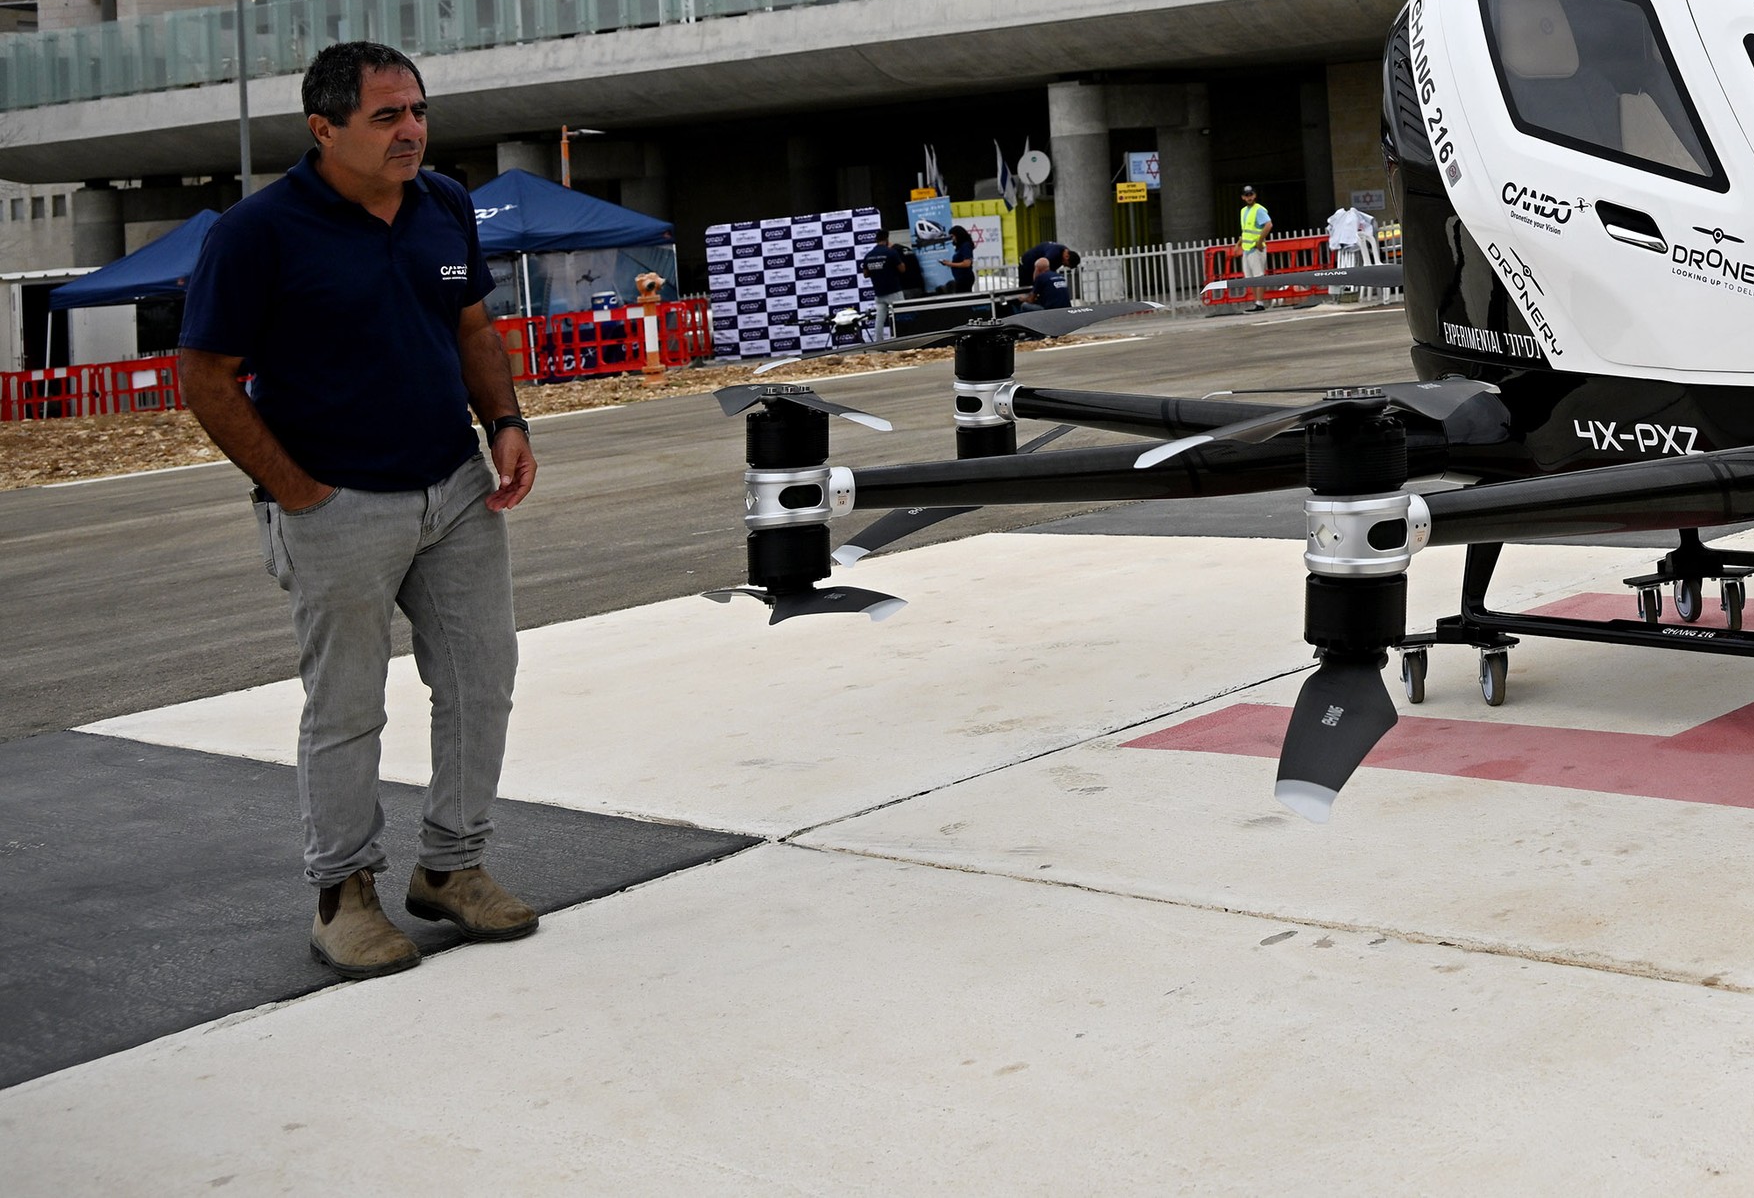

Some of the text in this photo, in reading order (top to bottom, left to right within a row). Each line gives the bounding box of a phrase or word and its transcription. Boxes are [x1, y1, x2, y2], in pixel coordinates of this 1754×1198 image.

[1428, 107, 1454, 164] 216
[1502, 182, 1572, 224] CANDO
[1510, 210, 1561, 235] Dronetize your Vision
[1671, 267, 1708, 283] LOOKING
[1710, 278, 1721, 286] UP
[1724, 282, 1735, 290] TO
[1487, 242, 1563, 356] DRONERY
[1443, 322, 1503, 354] EXPERIMENTAL
[1503, 332, 1542, 359] נסיוני
